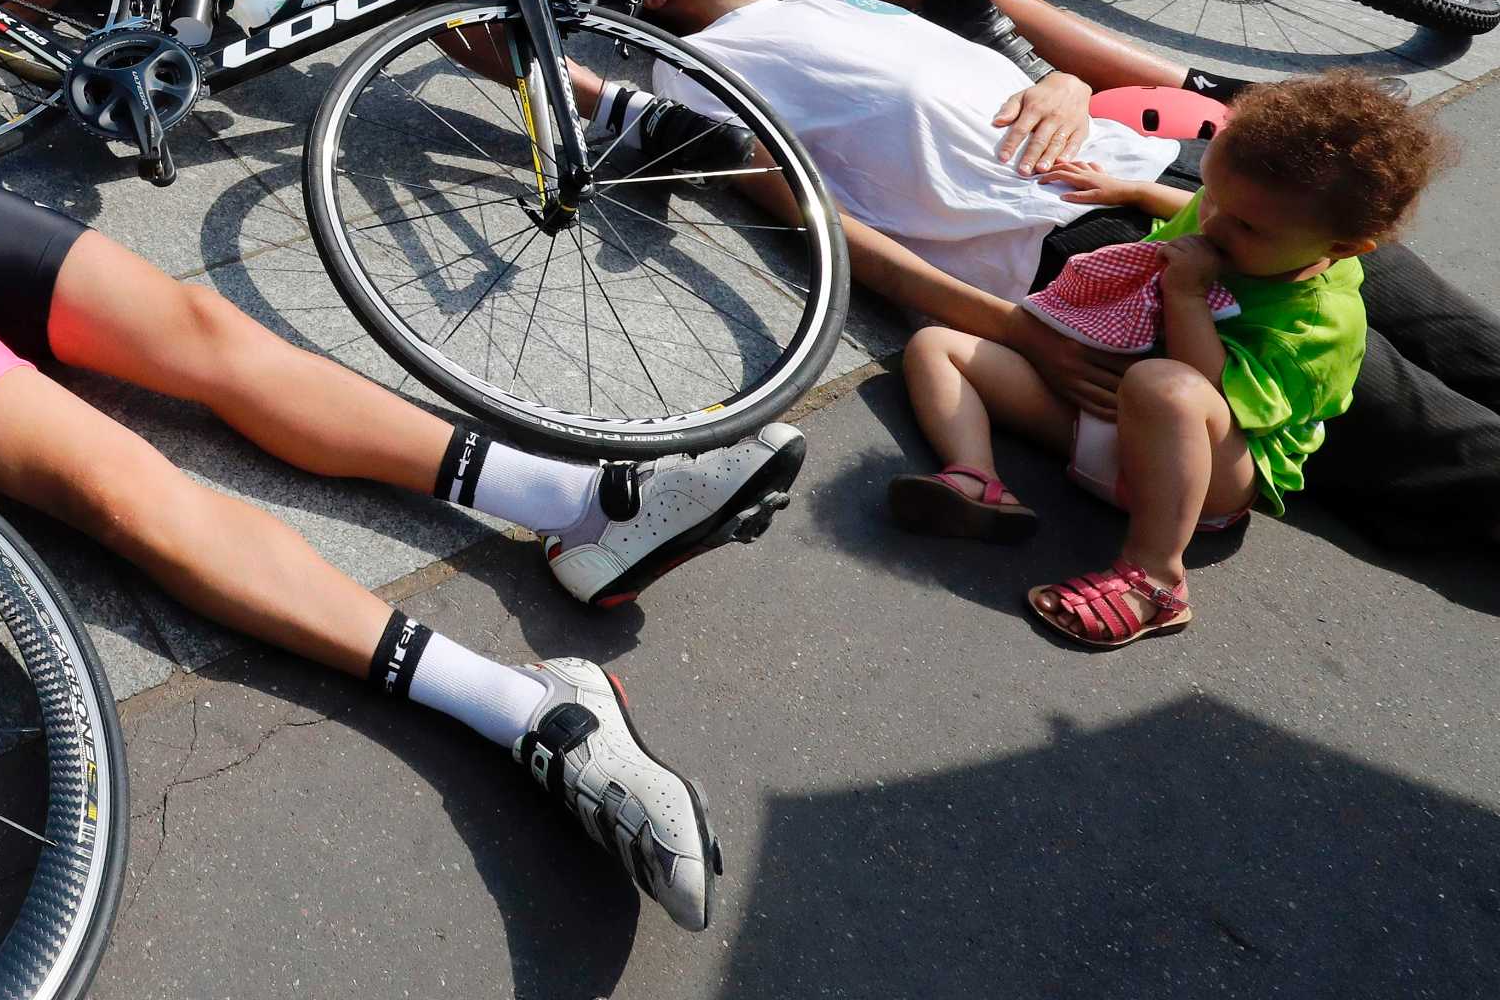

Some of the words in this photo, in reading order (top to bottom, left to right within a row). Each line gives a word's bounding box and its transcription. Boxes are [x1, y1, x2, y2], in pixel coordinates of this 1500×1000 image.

[15, 23, 50, 47] 765
[131, 70, 151, 112] ULTEGRA
[51, 631, 96, 764] CARBONE
